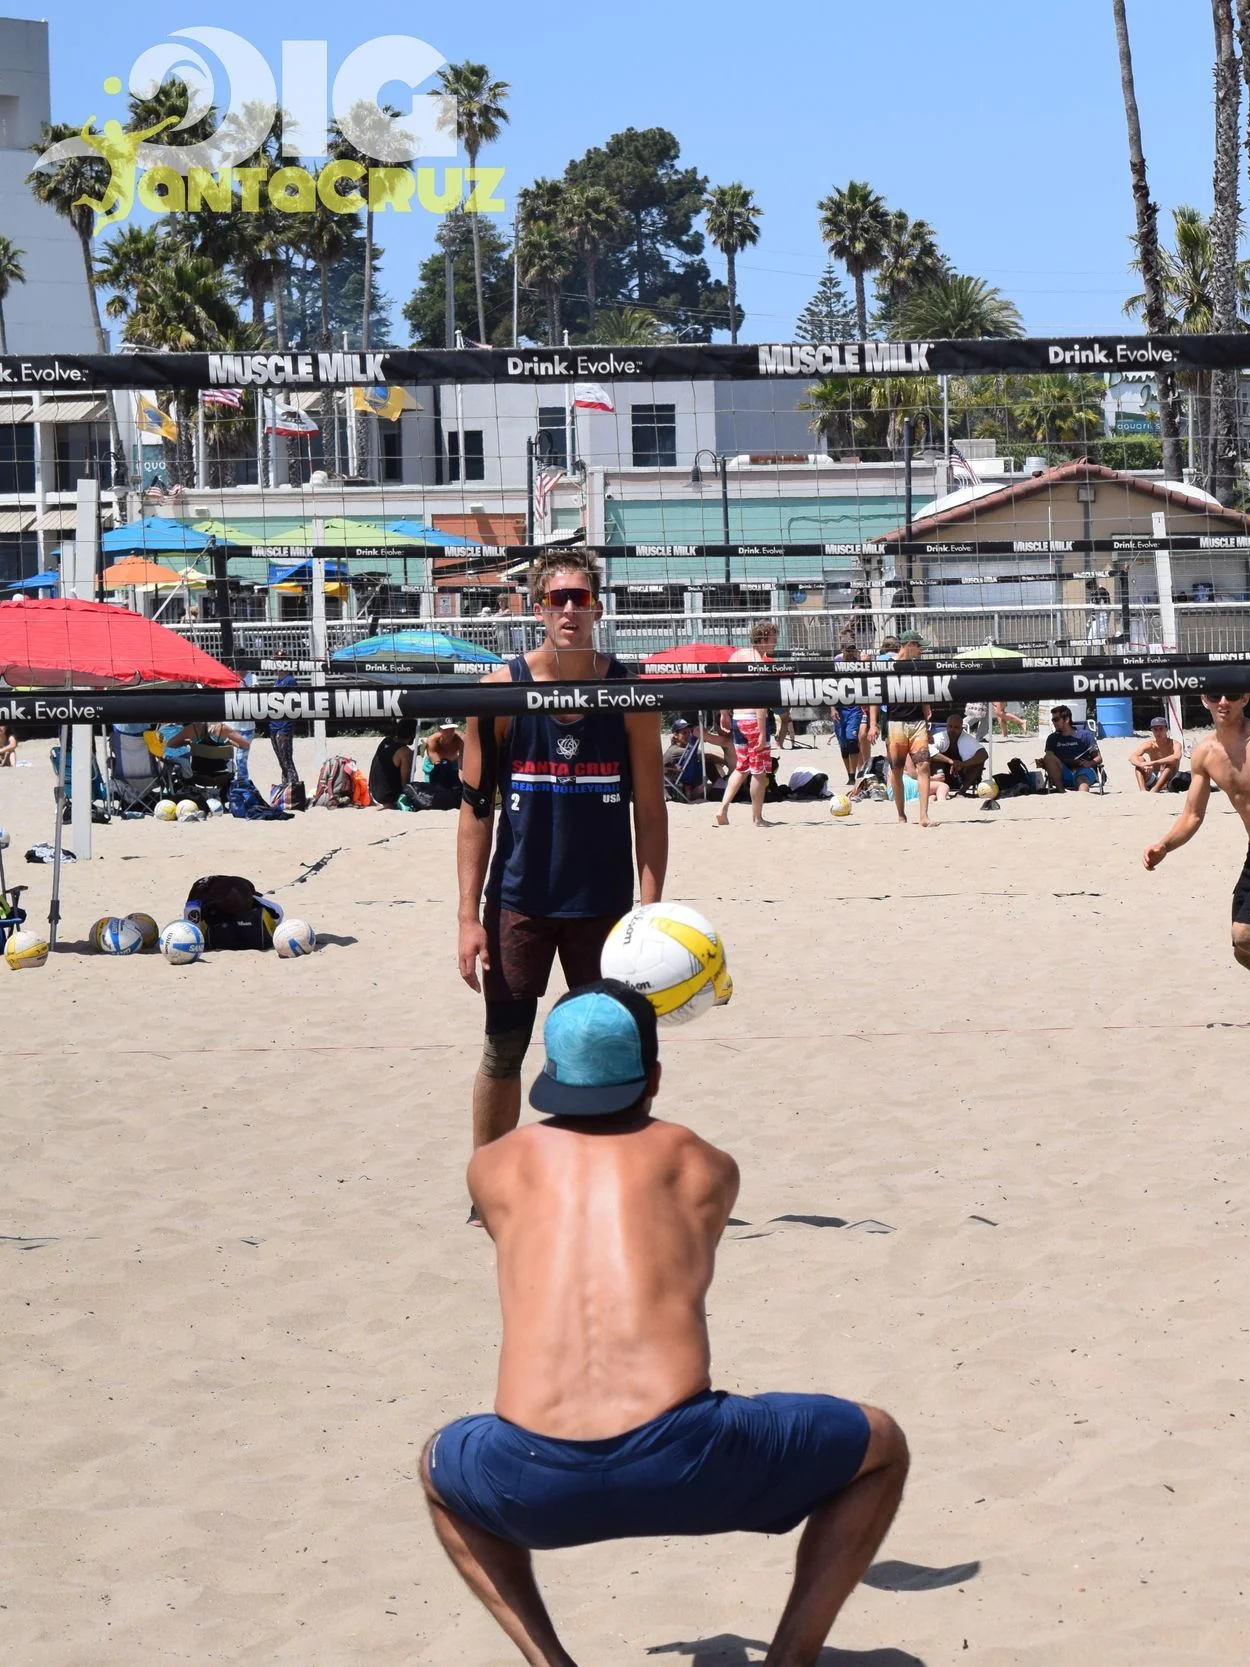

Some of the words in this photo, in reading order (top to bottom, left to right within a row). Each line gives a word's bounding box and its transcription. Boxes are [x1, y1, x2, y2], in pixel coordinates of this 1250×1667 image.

[758, 345, 859, 375] MUSCLE
[865, 343, 930, 372] MILK
[209, 355, 312, 384] MUSCLE
[318, 353, 386, 382] MILK
[1013, 542, 1048, 552] MUSCLE
[1050, 541, 1074, 551] MILK
[1200, 537, 1235, 547] MUSCLE
[251, 546, 289, 557] MUSCLE
[290, 546, 314, 557] MILK
[444, 547, 481, 557] MUSCLE
[483, 546, 506, 556] MILK
[636, 546, 672, 556] MUSCLE
[673, 546, 698, 556] MILK
[825, 544, 861, 554] MUSCLE
[862, 544, 886, 554] MILK
[261, 660, 297, 671] MUSCLE
[300, 661, 324, 671] MILK
[834, 662, 870, 671] MUSCLE
[872, 661, 895, 671] MILK
[1022, 658, 1058, 667] MUSCLE
[1059, 657, 1083, 666] MILK
[454, 663, 487, 673] MUSCLE
[645, 664, 681, 674] MUSCLE
[682, 663, 706, 673] MILK
[780, 677, 881, 706] MUSCLE
[887, 675, 956, 702] MILK
[225, 692, 329, 720] MUSCLE
[335, 690, 403, 717] MILK
[511, 760, 570, 776] SANTA
[575, 762, 621, 776] CRUZ
[511, 782, 551, 792] BEACH
[552, 783, 620, 794] VOLLEYBALL
[511, 793, 520, 811] 2
[602, 793, 621, 803] USA
